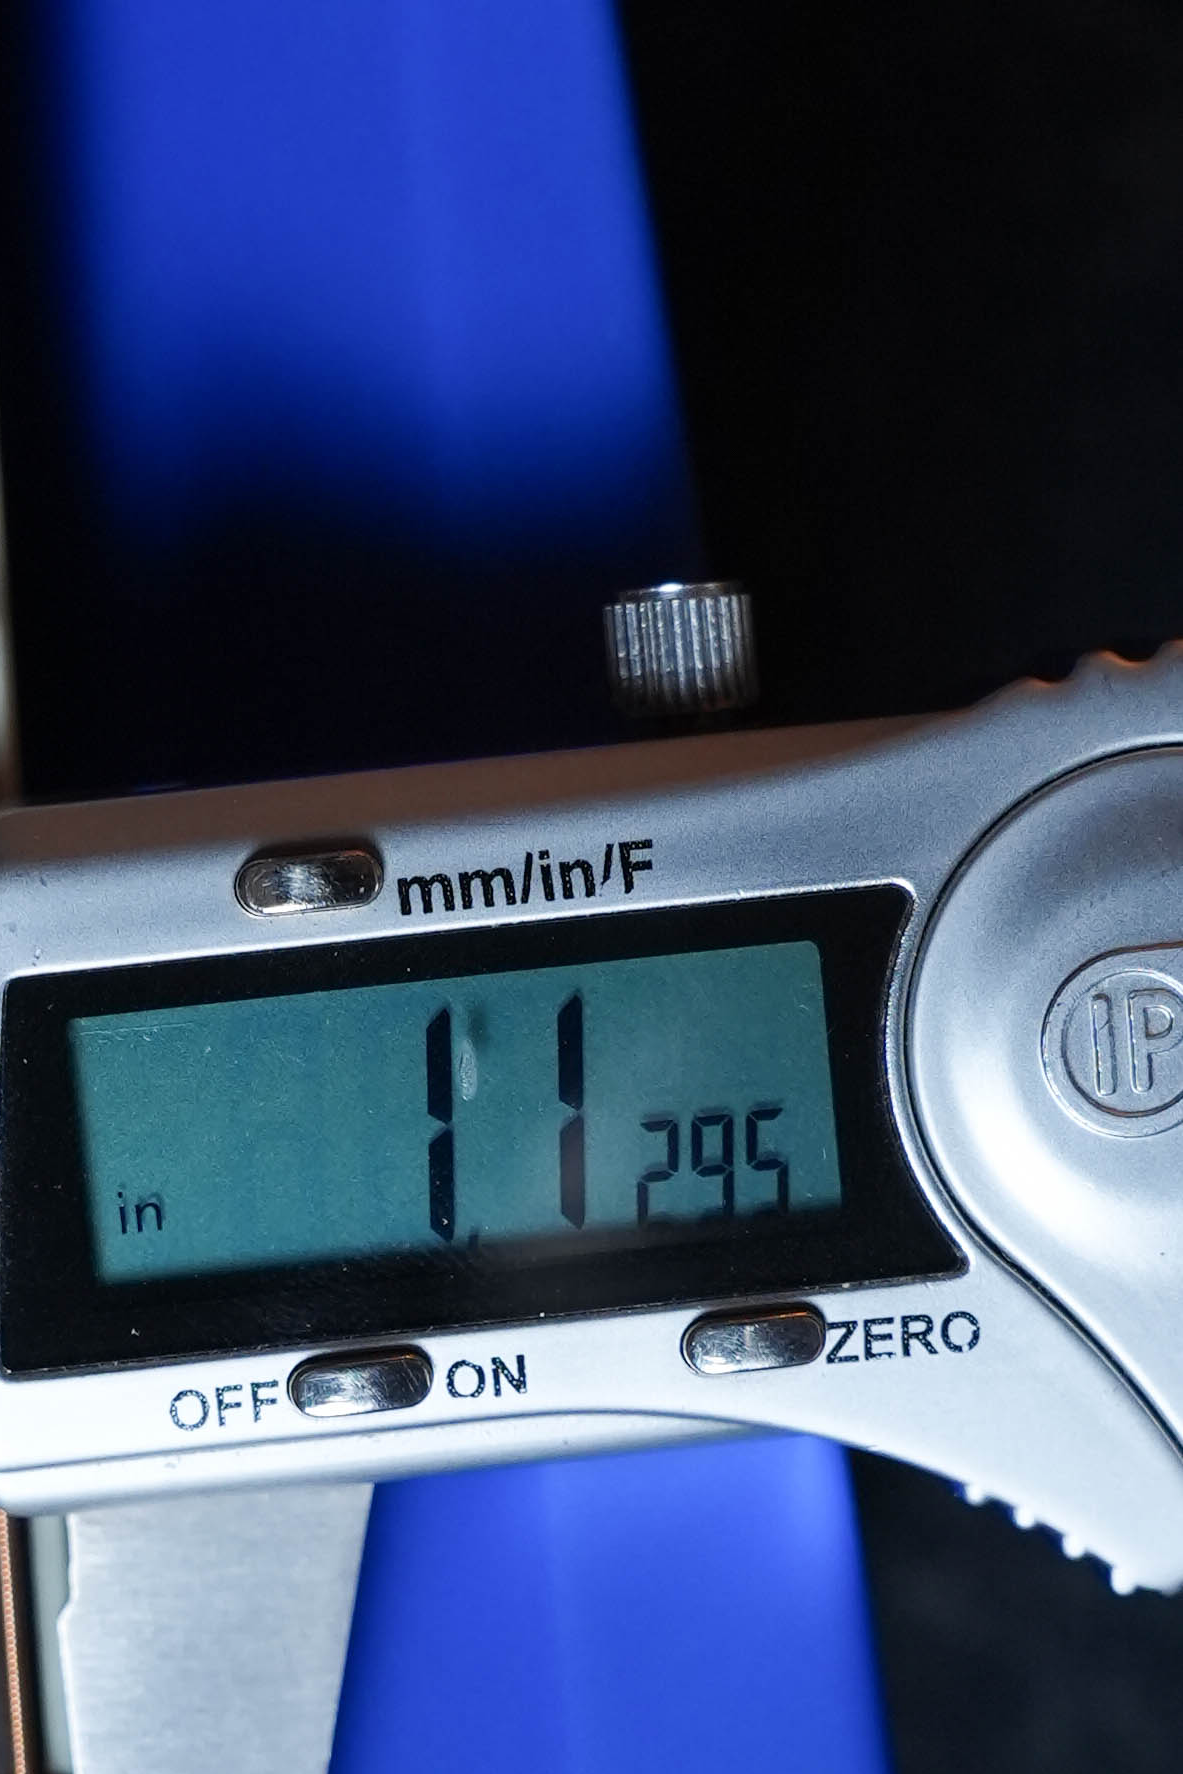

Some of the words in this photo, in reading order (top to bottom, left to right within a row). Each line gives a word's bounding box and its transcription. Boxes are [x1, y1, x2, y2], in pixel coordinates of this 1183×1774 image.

[397, 839, 653, 916] mm/in/F
[117, 1190, 164, 1235] in
[826, 1310, 981, 1364] ZERO
[446, 1354, 528, 1399] ON
[170, 1379, 279, 1432] OFF
